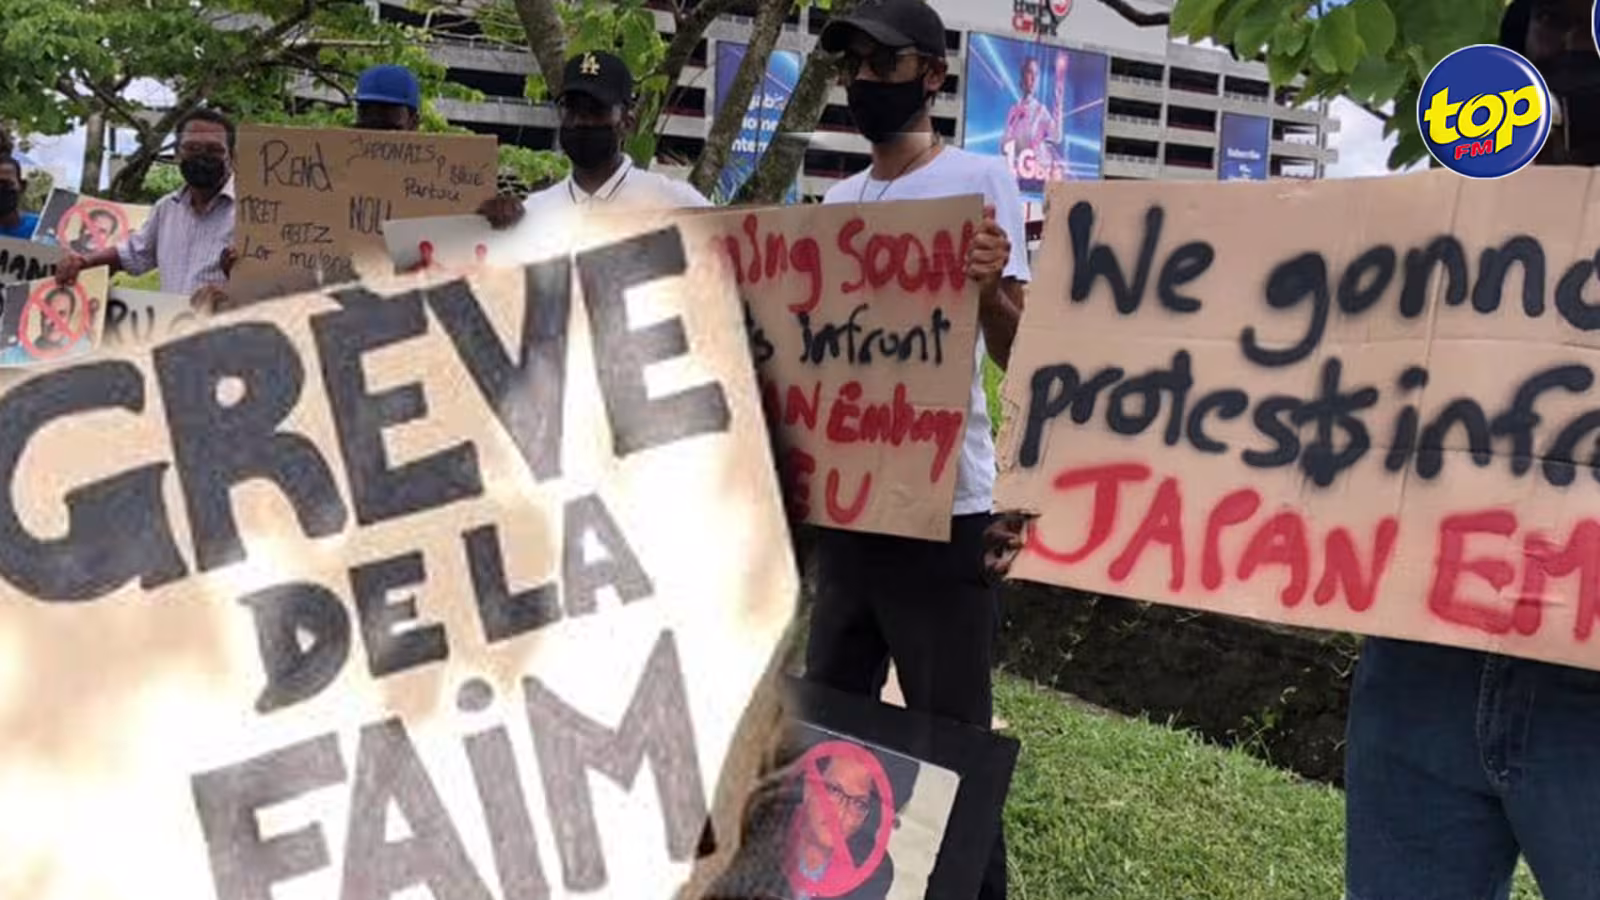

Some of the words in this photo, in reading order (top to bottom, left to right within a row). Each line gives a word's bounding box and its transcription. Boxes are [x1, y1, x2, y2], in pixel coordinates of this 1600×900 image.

[1067, 200, 1216, 315] We
[239, 550, 450, 715] DE
[461, 492, 656, 644] LA
[1027, 462, 1400, 613] JAPAN
[1427, 507, 1600, 644] EM
